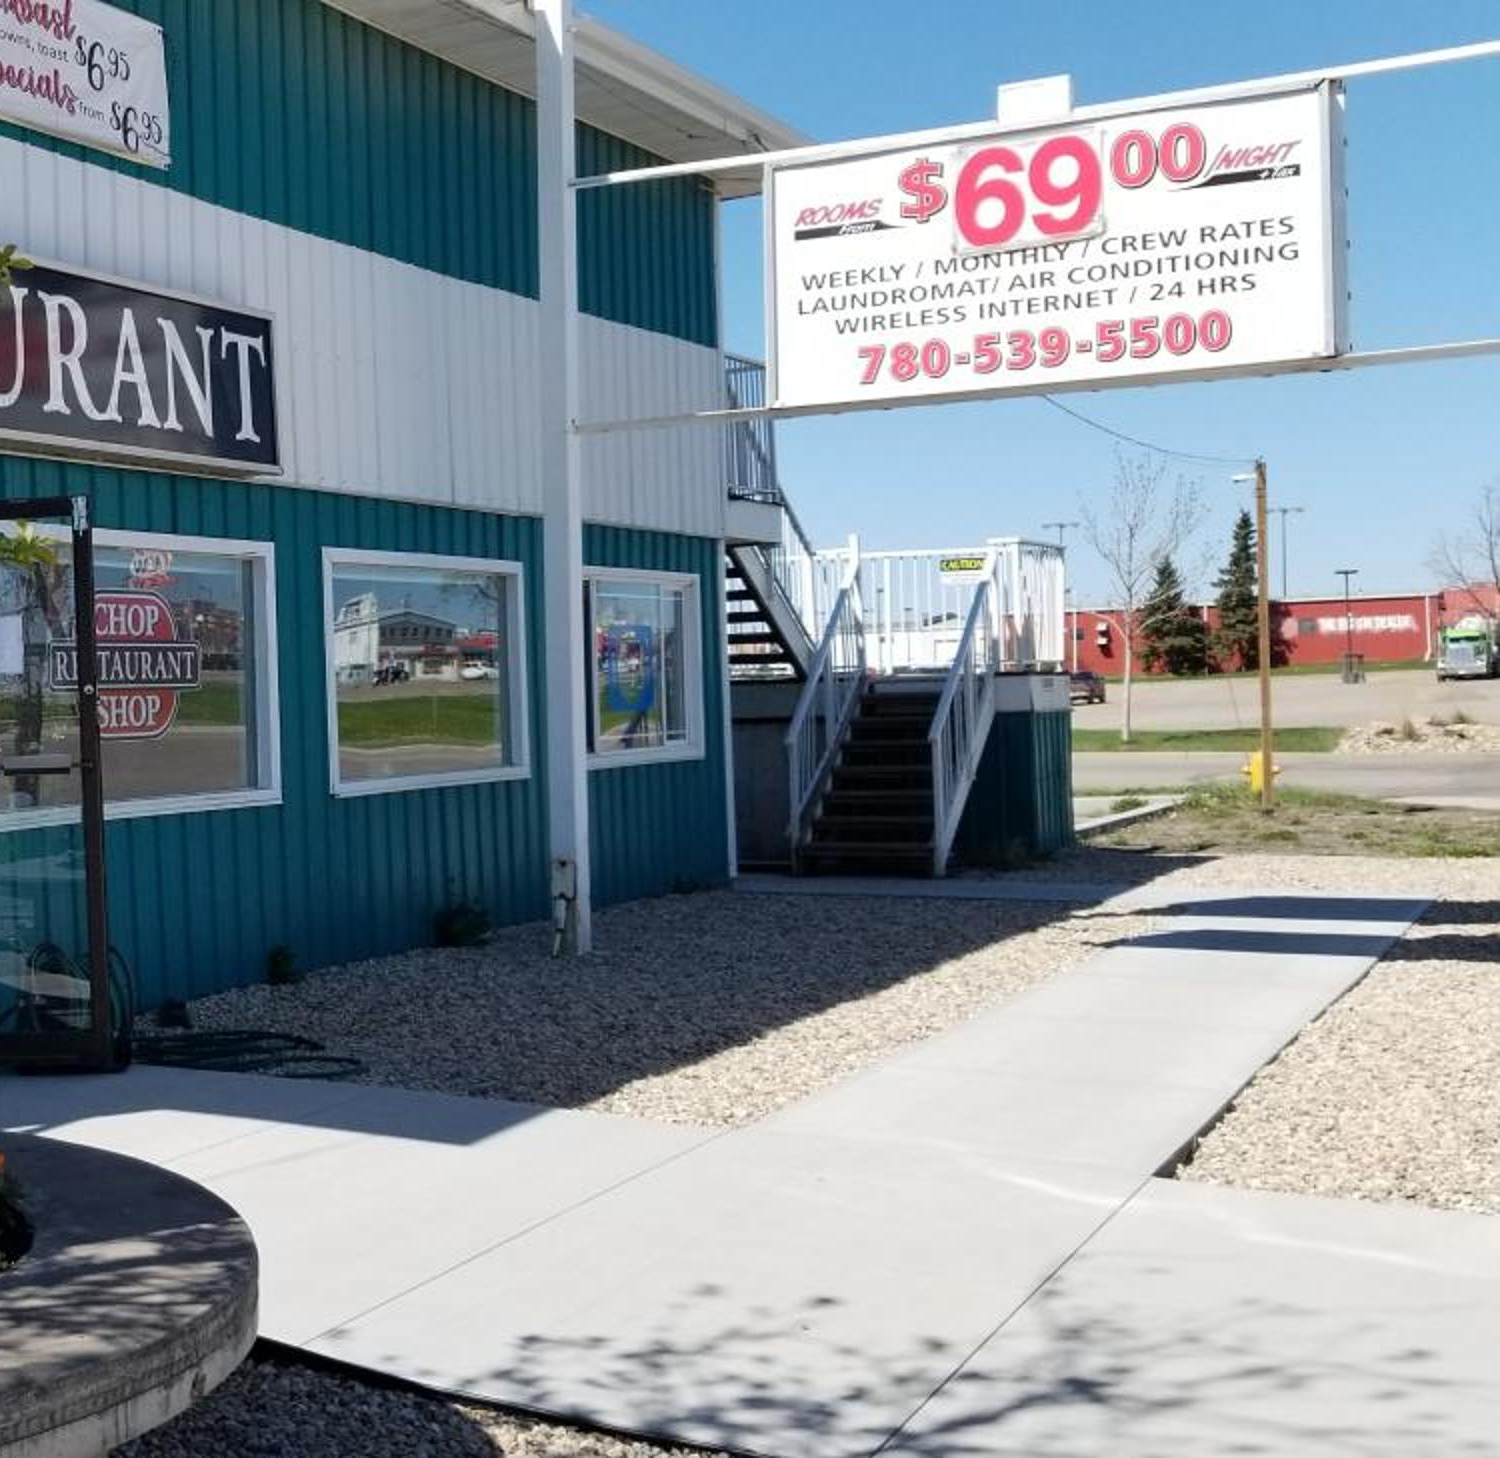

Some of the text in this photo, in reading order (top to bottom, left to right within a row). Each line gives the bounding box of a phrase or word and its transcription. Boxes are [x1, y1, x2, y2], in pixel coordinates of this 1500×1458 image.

[37, 42, 69, 63] toast
[79, 101, 105, 122] from
[794, 198, 883, 226] ROOMS
[802, 263, 904, 291] WEEKLY
[934, 243, 1072, 275] MONTHLY
[1100, 228, 1187, 255] CREW
[1199, 215, 1295, 243] RATES
[1007, 271, 1056, 292] AIR
[1067, 242, 1300, 284] CONDITIONING
[836, 306, 967, 335] WIRELESS
[979, 288, 1119, 320] INTERNET
[1149, 281, 1185, 301] 24
[1197, 273, 1257, 297] HRS
[857, 309, 1234, 385] 780-539-5500
[95, 603, 159, 636] CHOP
[55, 651, 195, 681] RTAURANT
[98, 695, 161, 727] SHOP
